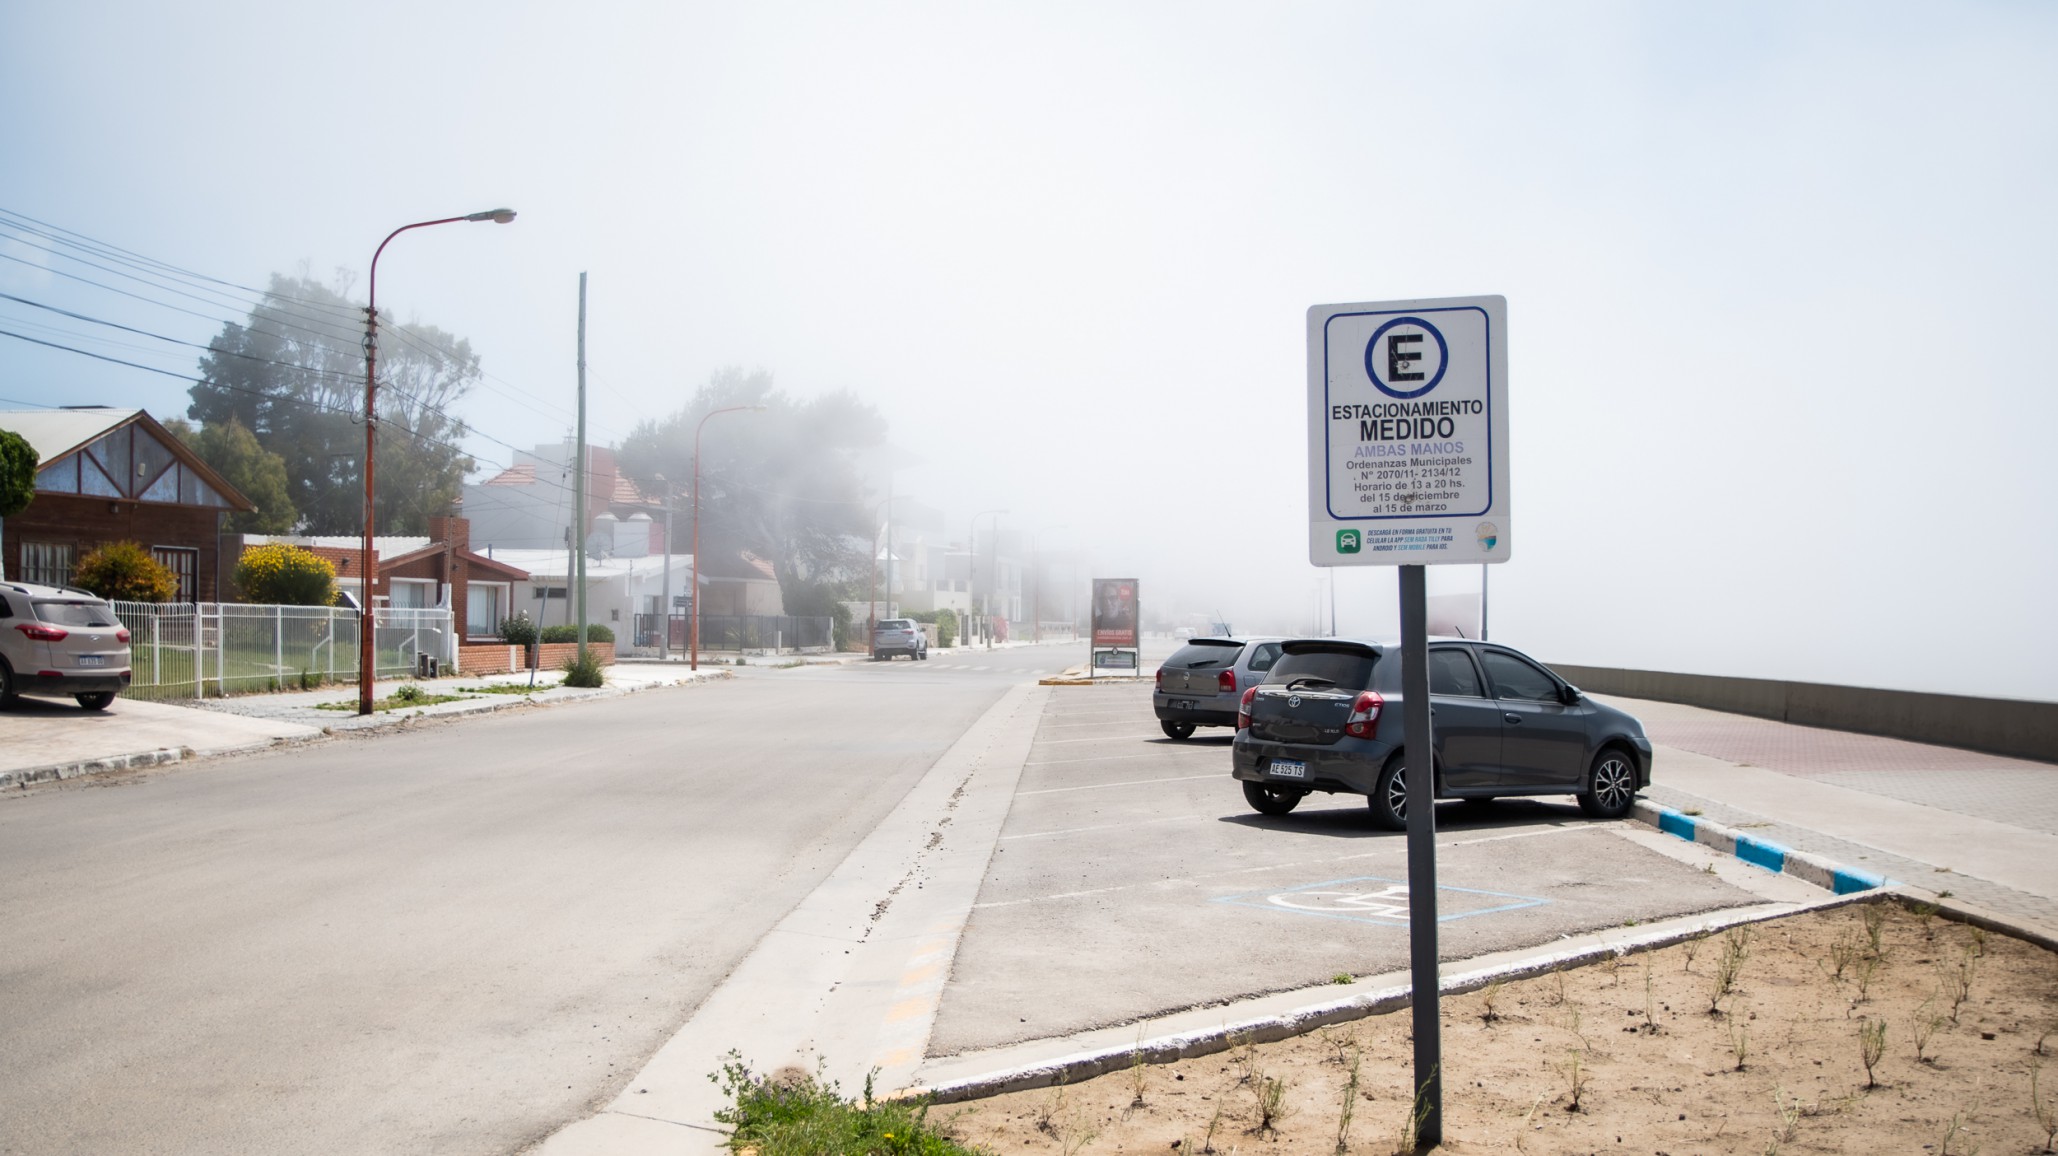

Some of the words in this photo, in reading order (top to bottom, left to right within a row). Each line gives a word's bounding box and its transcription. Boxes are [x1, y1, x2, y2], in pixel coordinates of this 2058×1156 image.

[1388, 334, 1424, 382] E
[1332, 399, 1483, 420] ESTACIONAMIENTO
[1360, 416, 1455, 442] MEDIDO
[1354, 444, 1407, 458] AMBAS
[1410, 441, 1464, 455] MANOS
[1346, 459, 1407, 470] Ordenanzas
[1410, 456, 1472, 467] Municipales
[1421, 467, 1461, 478] 2134/12
[1354, 482, 1392, 492] Horario
[1395, 481, 1408, 490] de
[1411, 480, 1422, 489] 13
[1425, 481, 1431, 489] a
[1434, 479, 1447, 488] 20
[1449, 479, 1465, 488] hs.
[1360, 493, 1376, 502] del
[1379, 493, 1390, 502] 15
[1393, 492, 1406, 501] de
[1373, 505, 1382, 513] al
[1385, 504, 1397, 513] 15
[1400, 503, 1412, 512] de
[1271, 764, 1280, 774] AE
[1280, 764, 1292, 775] 525
[1294, 766, 1304, 776] TS
